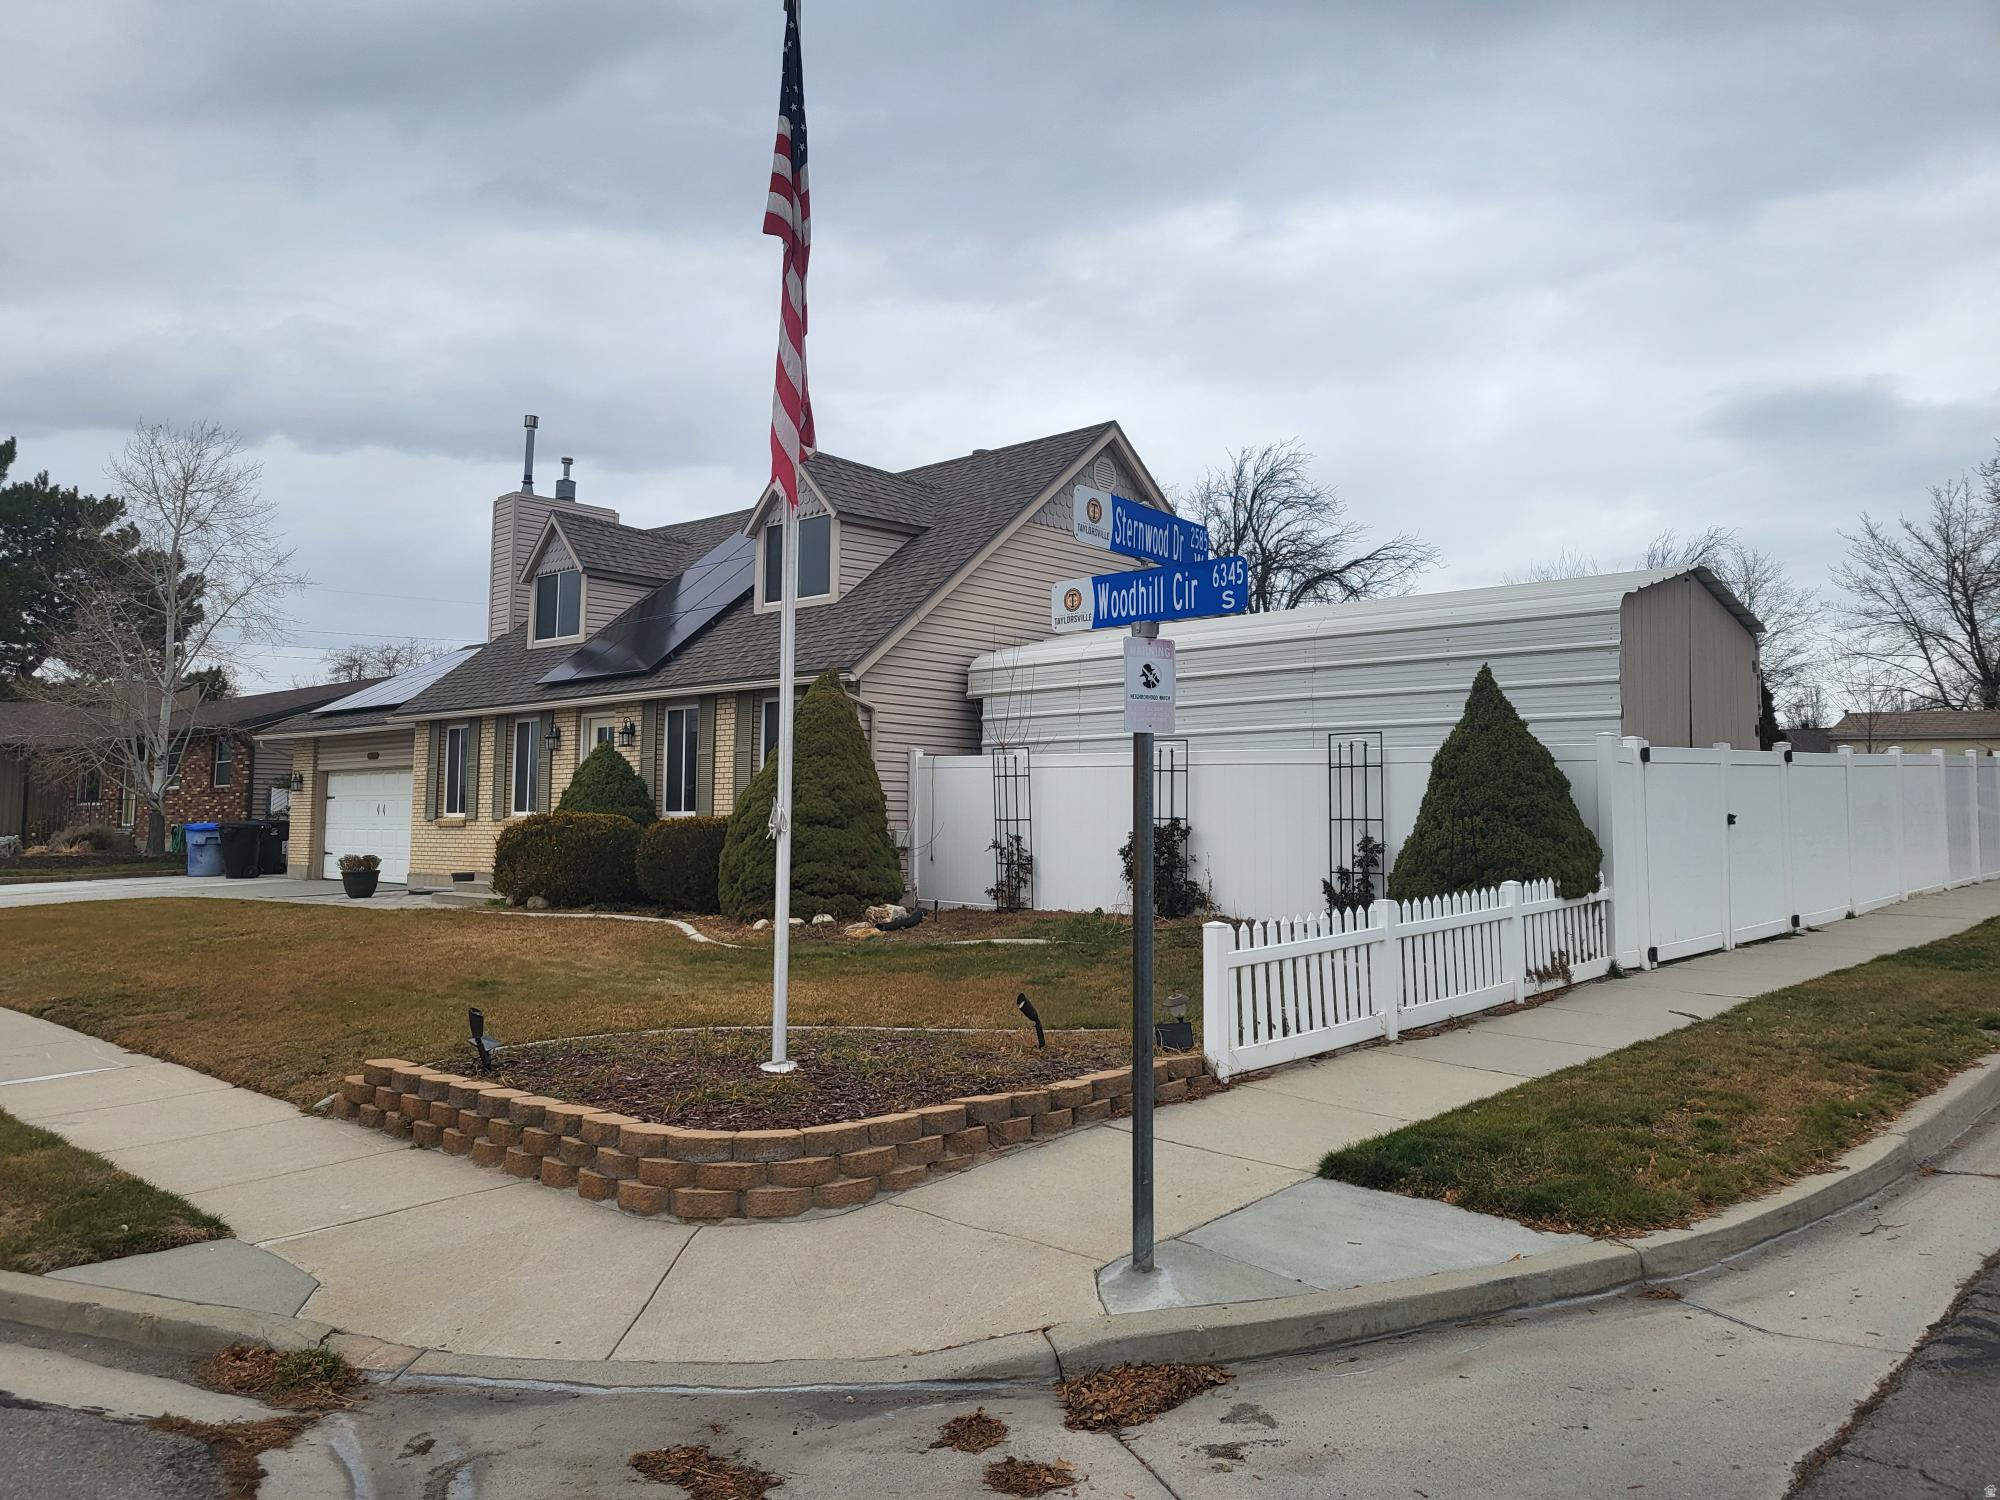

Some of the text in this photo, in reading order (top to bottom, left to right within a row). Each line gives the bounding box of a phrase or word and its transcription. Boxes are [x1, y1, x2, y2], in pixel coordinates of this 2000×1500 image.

[1077, 522, 1110, 540] TAYLORSVILLE
[1114, 506, 1184, 562] Sternwood Dr
[1190, 526, 1208, 552] 2585
[1212, 560, 1244, 588] 6345
[1097, 571, 1198, 620] Woodhill Cir
[1221, 590, 1236, 609] S
[1054, 613, 1092, 625] TAYLORSVILLE
